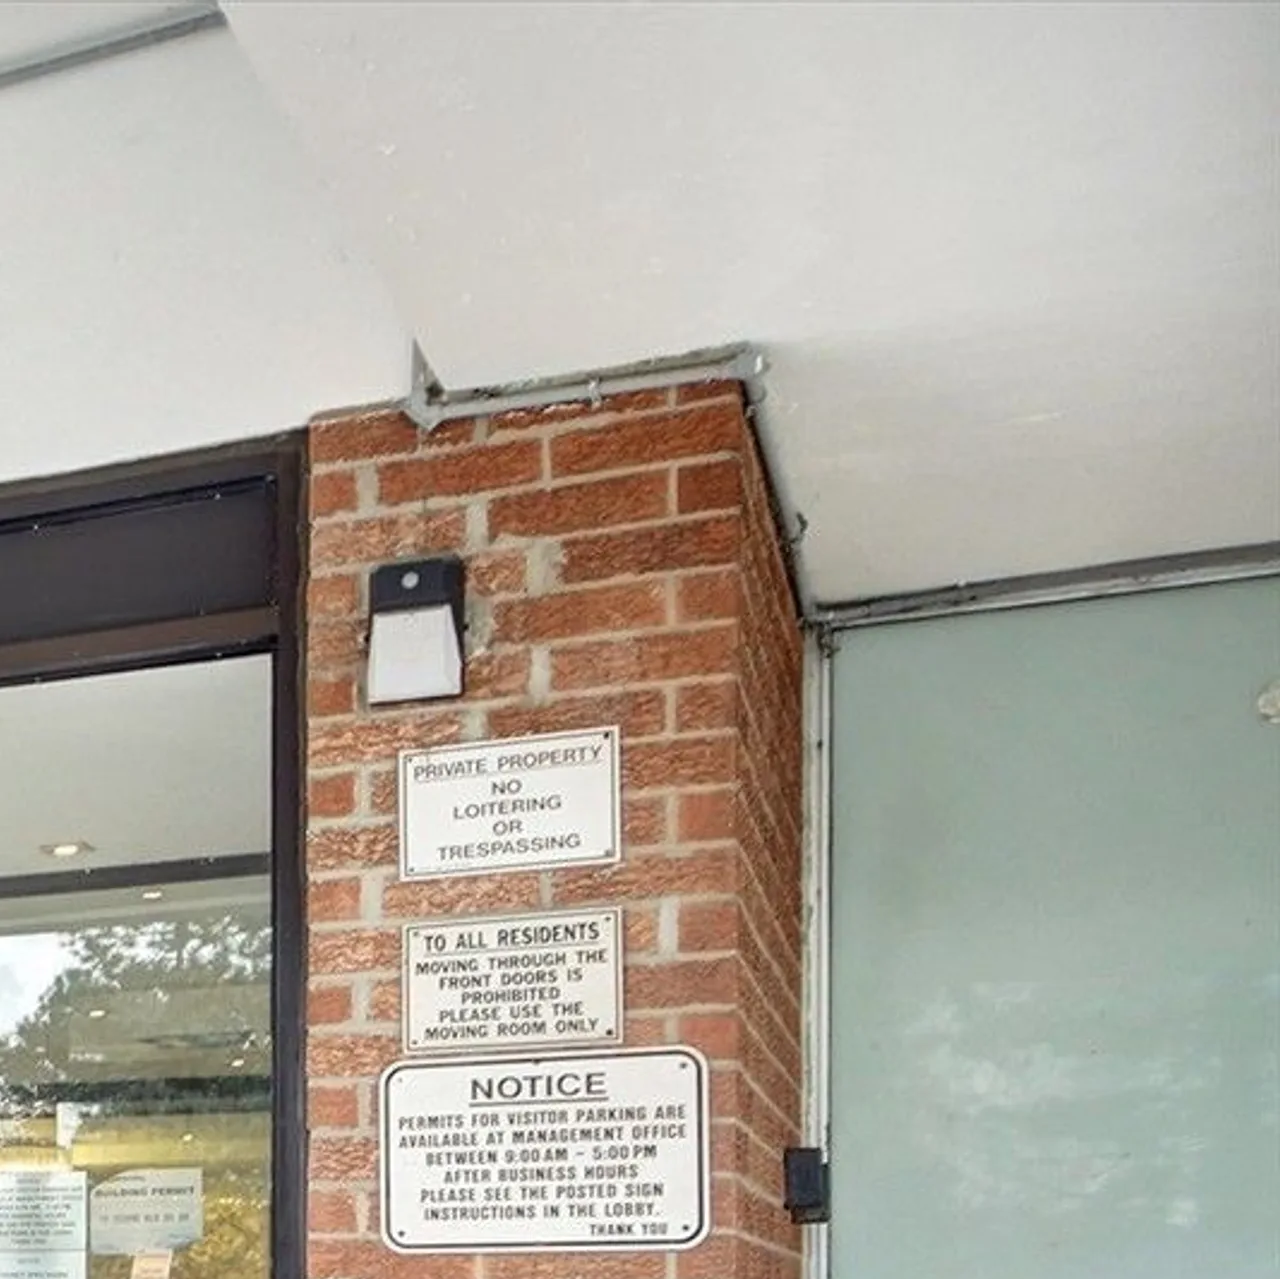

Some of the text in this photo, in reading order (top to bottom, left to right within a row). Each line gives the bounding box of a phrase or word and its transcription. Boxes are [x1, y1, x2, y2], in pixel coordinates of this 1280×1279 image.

[413, 745, 602, 781] PRIVATE PROPERTY
[491, 779, 522, 795] NO
[453, 795, 562, 820] LOITERING
[492, 820, 523, 836] OR
[437, 833, 581, 861] TRESPASSING
[424, 922, 600, 952] TO ALL RESIDENTS
[415, 949, 608, 976] MOVING THROUGH THE
[439, 968, 583, 990] FRONT DOORS IS
[461, 987, 561, 1005] PROHIBITED
[439, 1001, 584, 1023] PLEASE USE THE
[424, 1018, 600, 1041] MOVING ROOM ONLY
[470, 1072, 607, 1100] NOTICE
[399, 1104, 686, 1130] PERMITS FOR VISITOR PARKING ARE
[399, 1123, 686, 1149] AVAILABLE AT MANAGEMENT OFFICE
[425, 1151, 498, 1167] BETWEEN
[444, 1163, 639, 1184] AFTER BUSINESS HOURS
[420, 1182, 664, 1203] PLEASE SEE THE POSTED SIGN
[424, 1204, 537, 1221] INSTRUCTIONS
[543, 1204, 560, 1218] IN
[568, 1203, 598, 1217] THE
[590, 1222, 668, 1236] THANK YOU
